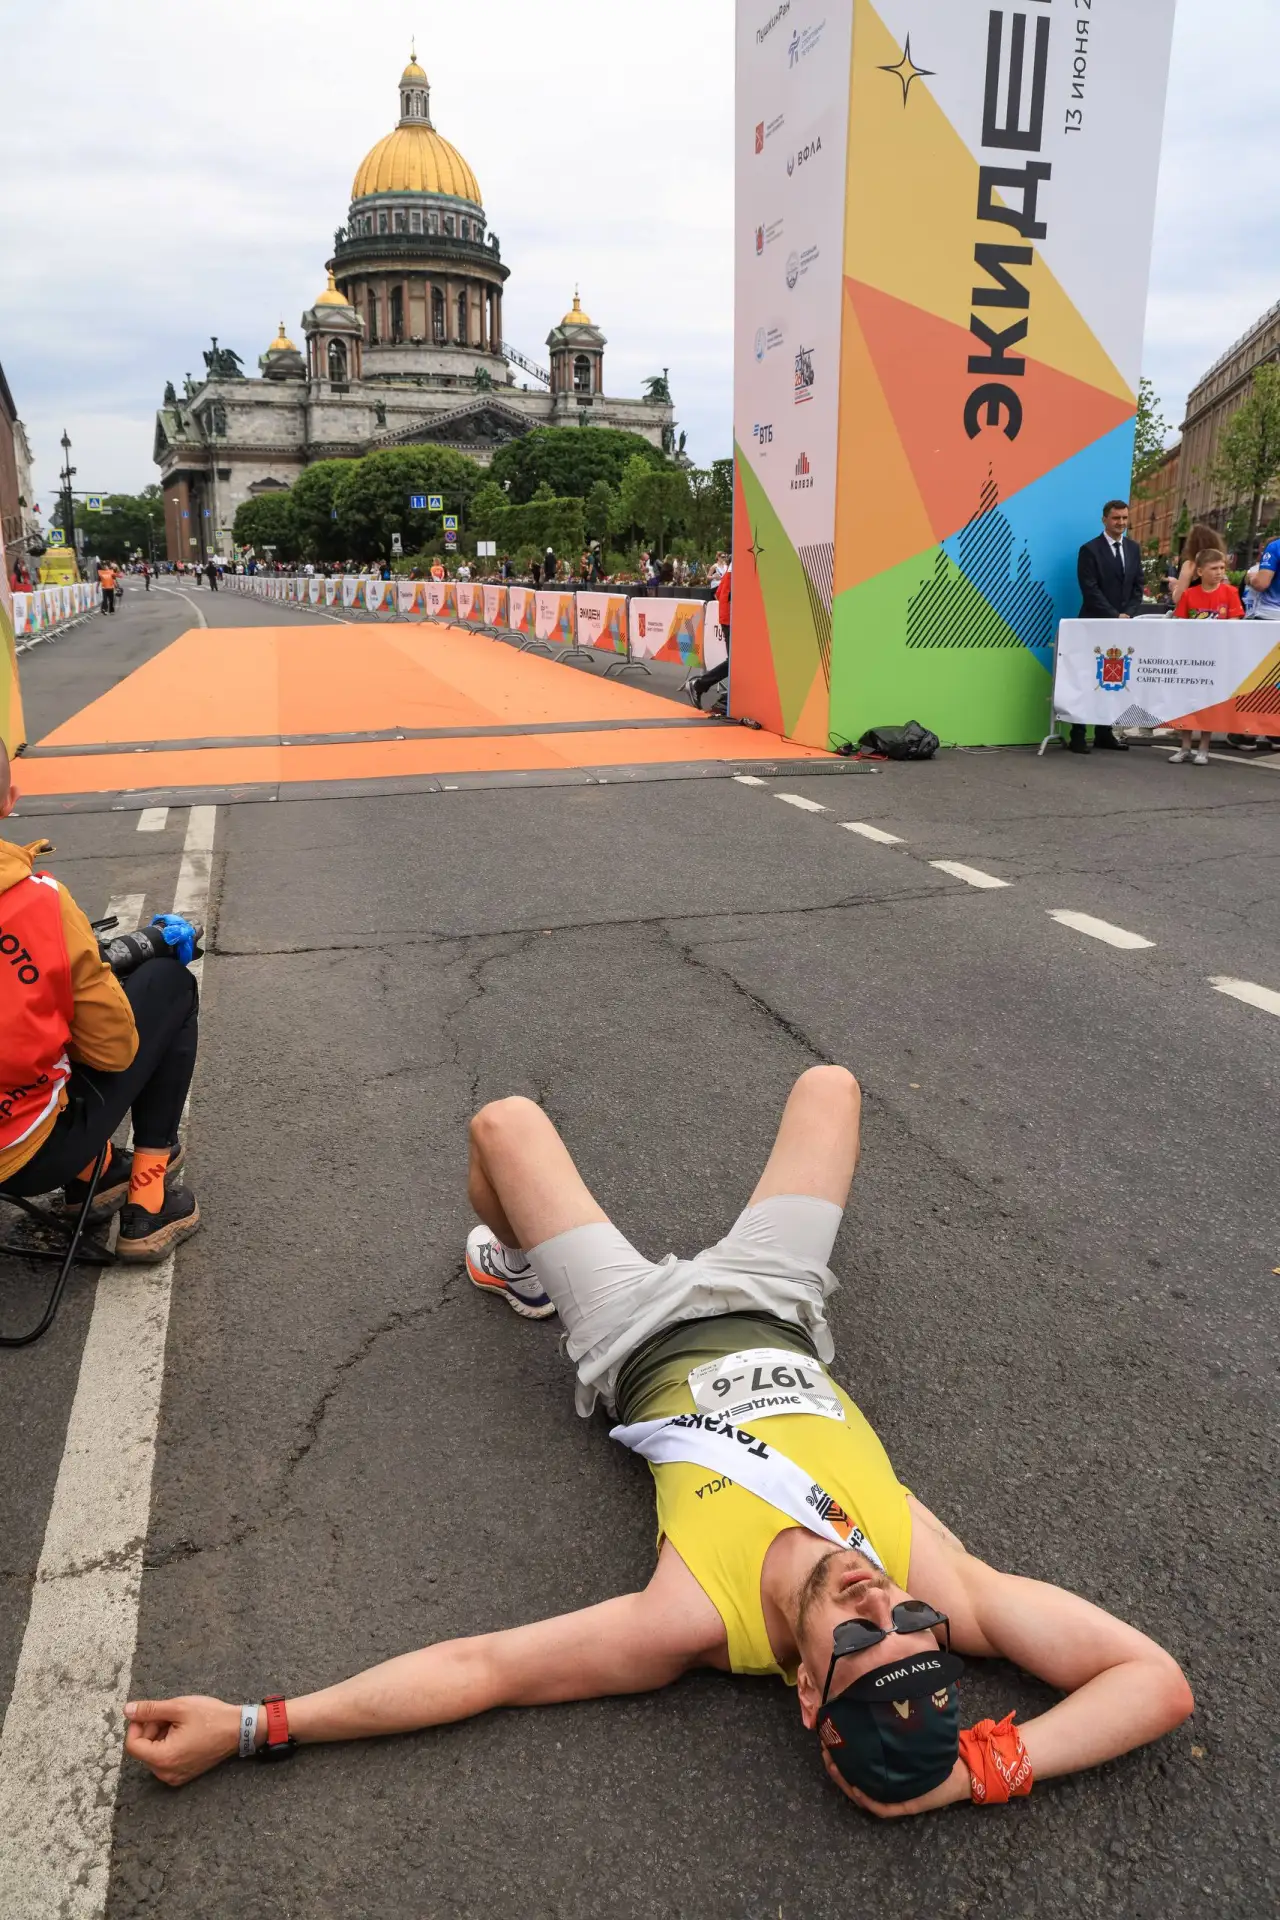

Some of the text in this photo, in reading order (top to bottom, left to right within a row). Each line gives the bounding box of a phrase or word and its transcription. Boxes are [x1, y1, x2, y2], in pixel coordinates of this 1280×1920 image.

[1071, 19, 1090, 99] июня
[1064, 109, 1083, 135] 13
[797, 136, 822, 167] ВФЛА
[963, 0, 1052, 442] ЭКИДЕ
[759, 424, 773, 445] ВТБ
[1137, 667, 1179, 675] СОБРАНИЕ
[1138, 657, 1217, 667] ЗАКОНОДАТЕЛЬНОЕ
[1136, 675, 1215, 686] САНКТ-ПЕТЕРБУРГА
[712, 1366, 815, 1398] 197-6
[717, 1396, 802, 1421] ЭКИДЕН
[875, 1659, 941, 1687] STAY WILD
